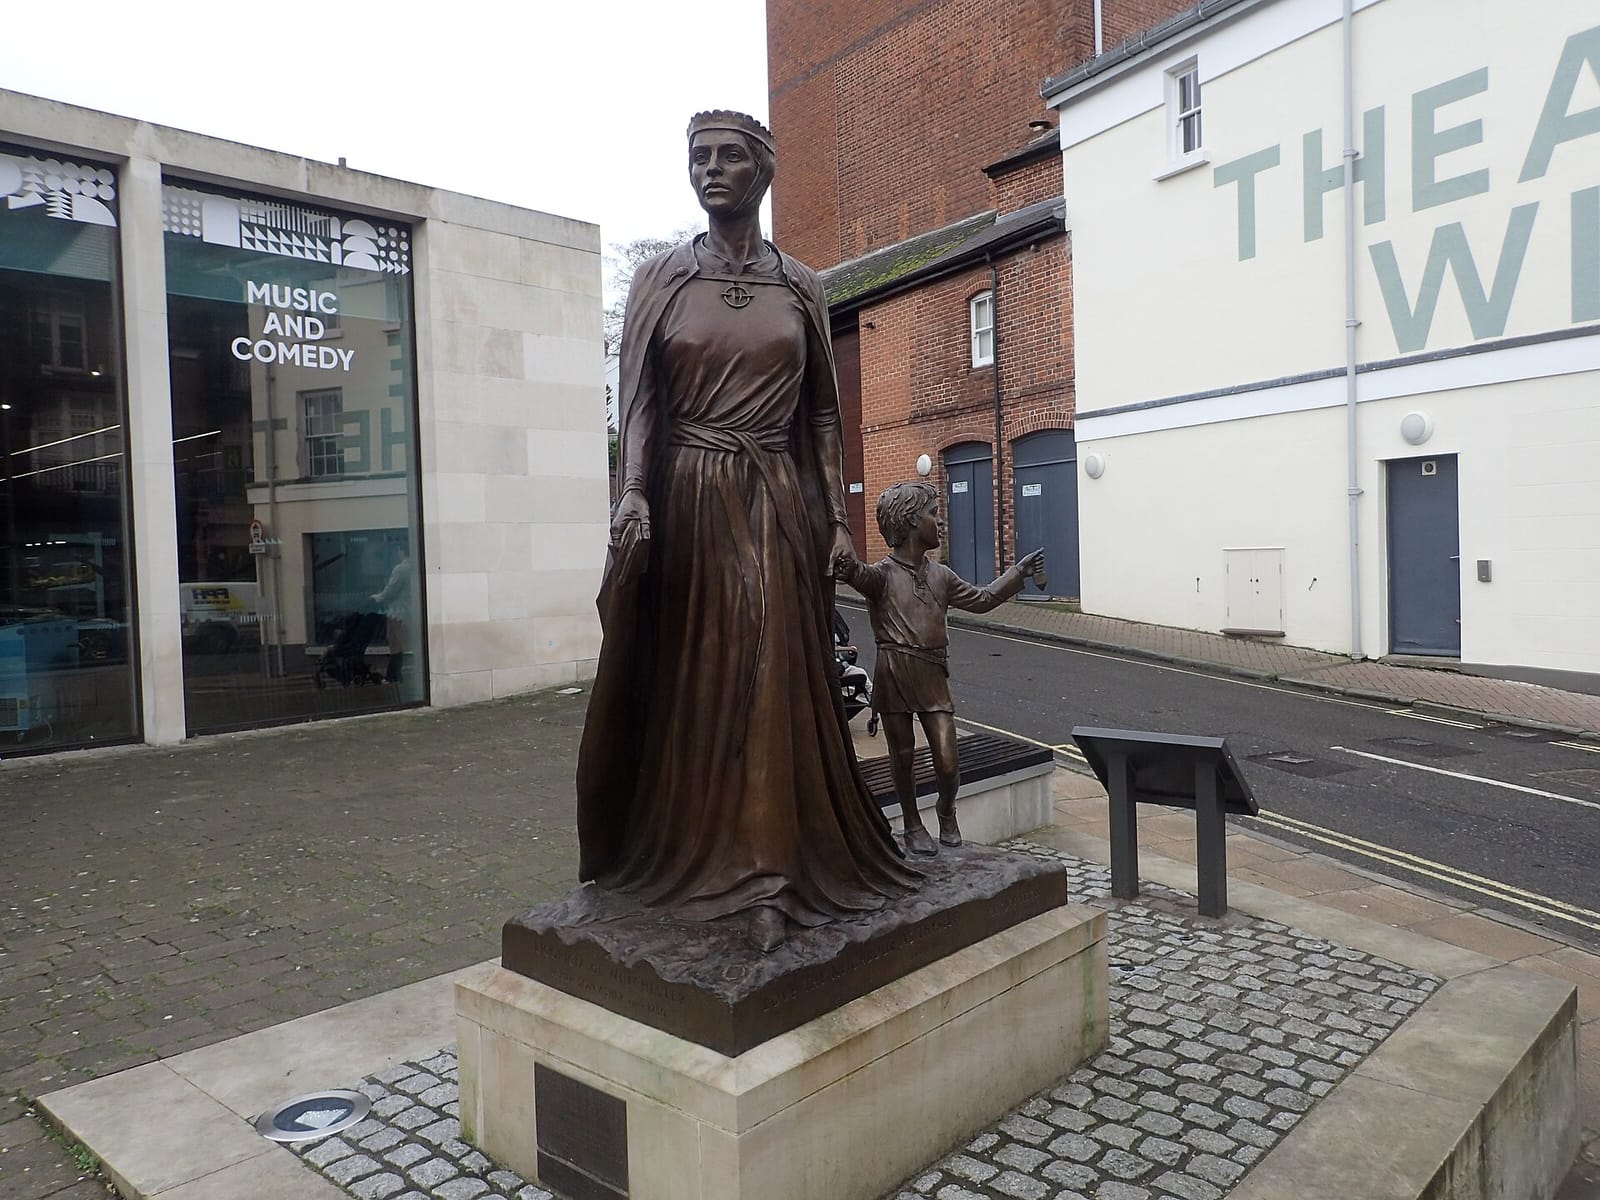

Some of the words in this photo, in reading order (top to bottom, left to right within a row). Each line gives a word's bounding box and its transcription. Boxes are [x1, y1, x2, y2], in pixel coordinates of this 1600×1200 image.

[247, 280, 338, 315] MUSIC
[262, 312, 325, 340] AND
[231, 336, 355, 371] COMEDY
